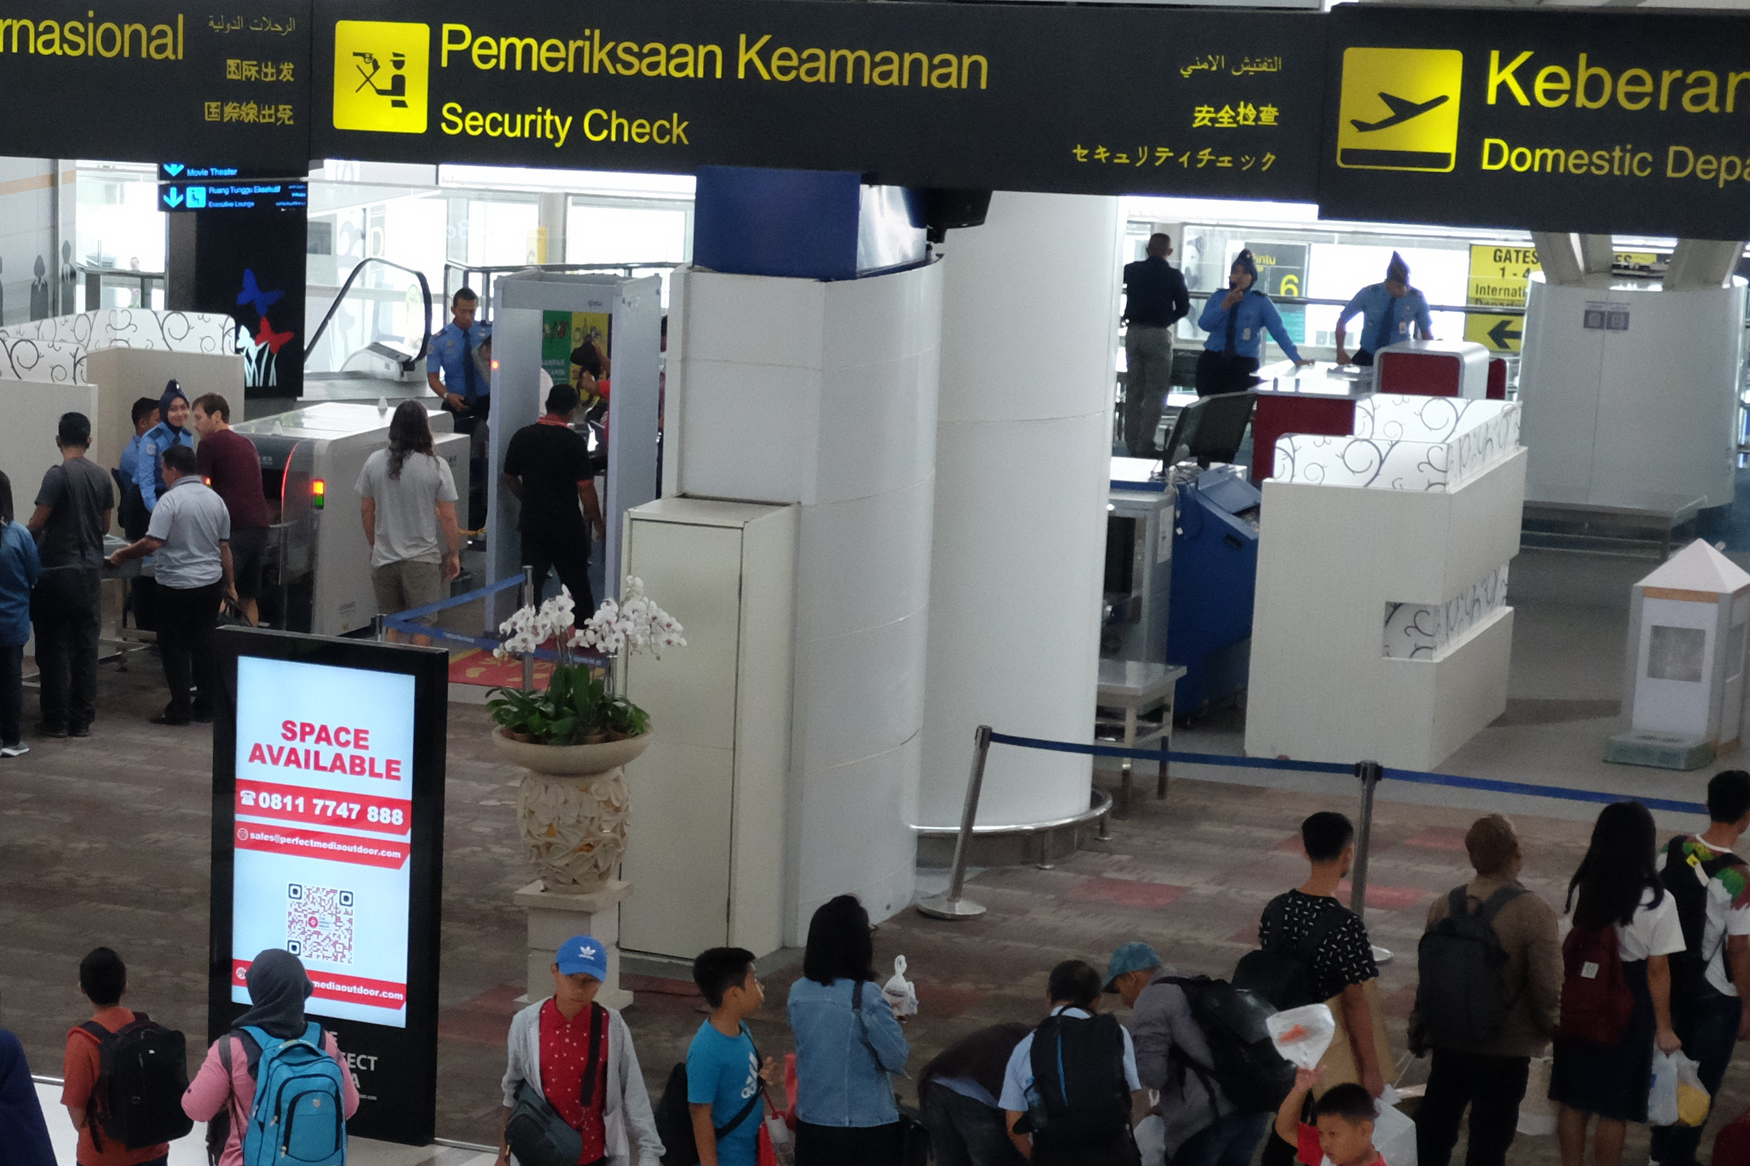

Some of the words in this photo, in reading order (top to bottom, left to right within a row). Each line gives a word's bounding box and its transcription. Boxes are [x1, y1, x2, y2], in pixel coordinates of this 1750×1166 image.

[250, 16, 296, 36] الرحلات
[441, 23, 723, 79] Pemeriksaan
[737, 33, 989, 90] Keamanan
[1231, 56, 1282, 76] التفتيش
[226, 59, 295, 82] 国际出发
[440, 102, 573, 148] Security
[582, 108, 690, 145] Check
[1192, 100, 1280, 128] 安全检查
[1072, 144, 1277, 172] セキュリティチェック
[1481, 138, 1654, 178] Domestic
[1666, 145, 1750, 189] Dep
[1252, 253, 1276, 265] intu
[1493, 248, 1539, 265] GATES
[1499, 266, 1506, 278] 1
[1280, 274, 1299, 297] 6
[1475, 284, 1527, 298] Internati
[281, 720, 370, 750] SPACE
[248, 742, 402, 781] AVAILABLE
[258, 791, 305, 813] 0811
[312, 798, 361, 820] 7747
[367, 805, 403, 826] 888
[249, 831, 402, 859] sales@perfectmediaoutdoor.com
[312, 980, 404, 1001] mediaoutdoor.com
